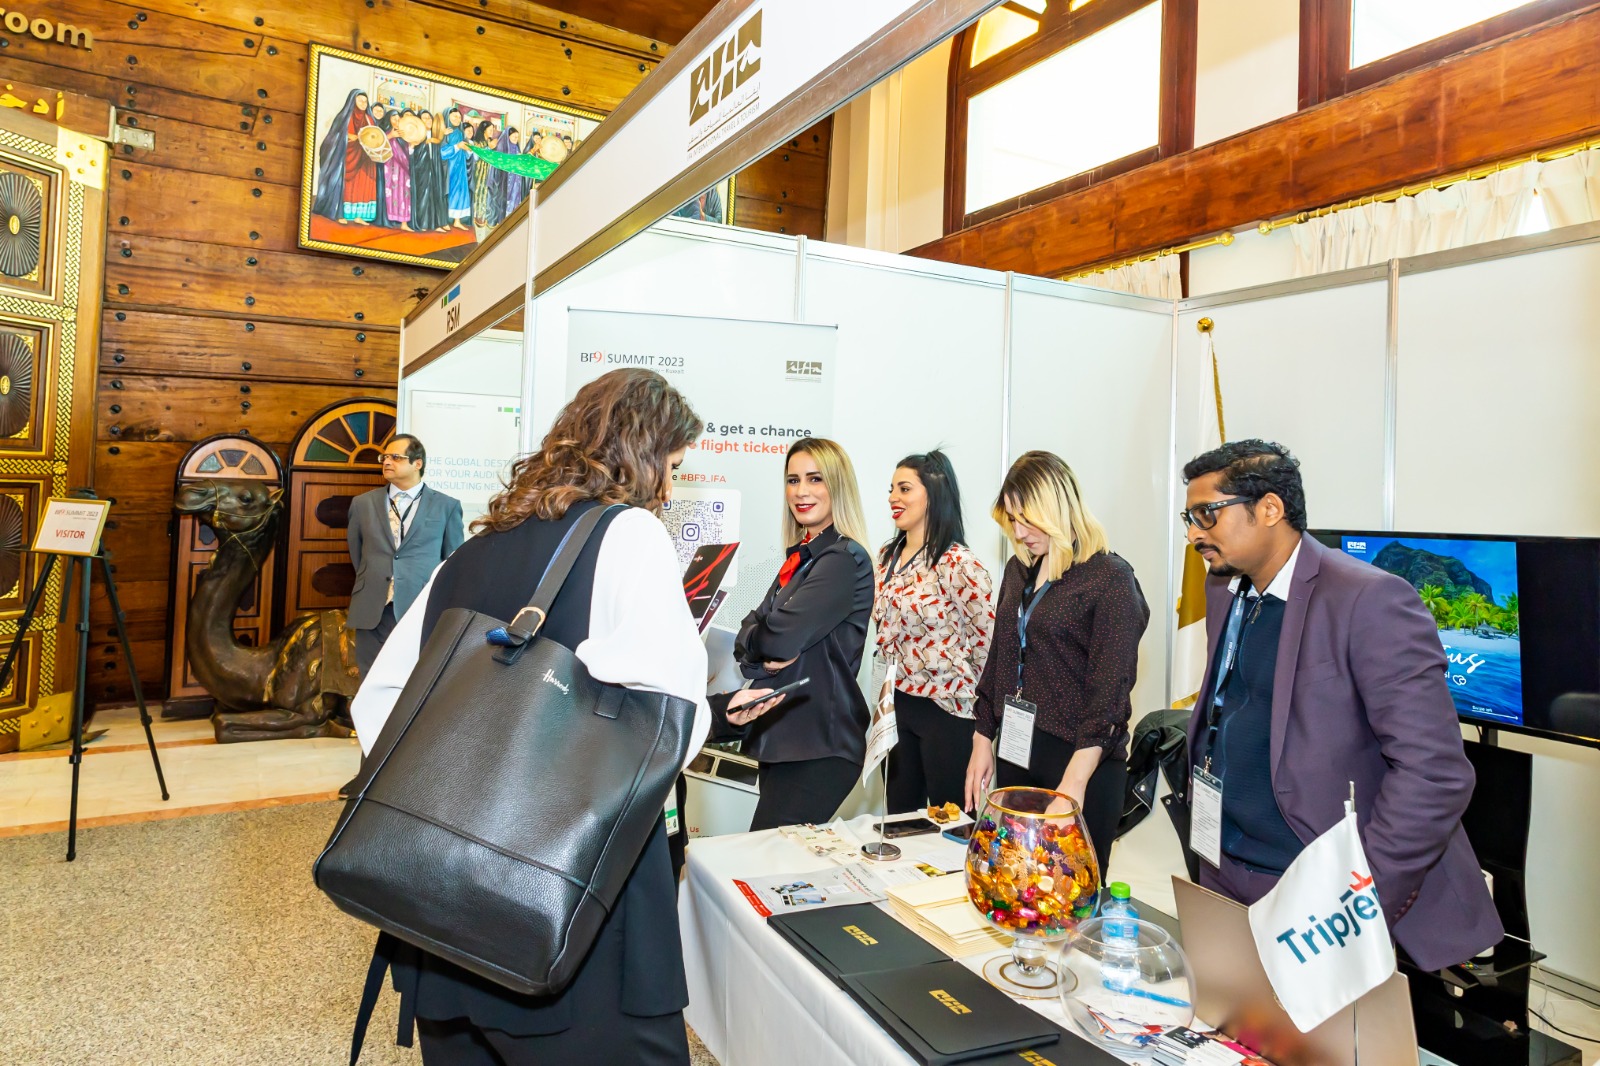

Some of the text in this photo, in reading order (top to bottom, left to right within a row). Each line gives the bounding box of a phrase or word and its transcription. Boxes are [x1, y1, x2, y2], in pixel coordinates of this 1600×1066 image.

[446, 302, 461, 334] RSM
[607, 353, 655, 365] SUMMIT
[658, 356, 685, 367] 2023
[706, 422, 812, 438] & get a chance
[701, 439, 739, 454] flight
[743, 441, 789, 454] ticket!
[444, 457, 482, 467] GLOBAL
[444, 469, 471, 478] YOUR
[680, 473, 727, 483] #BF9_IFA
[55, 529, 85, 539] VISITOR
